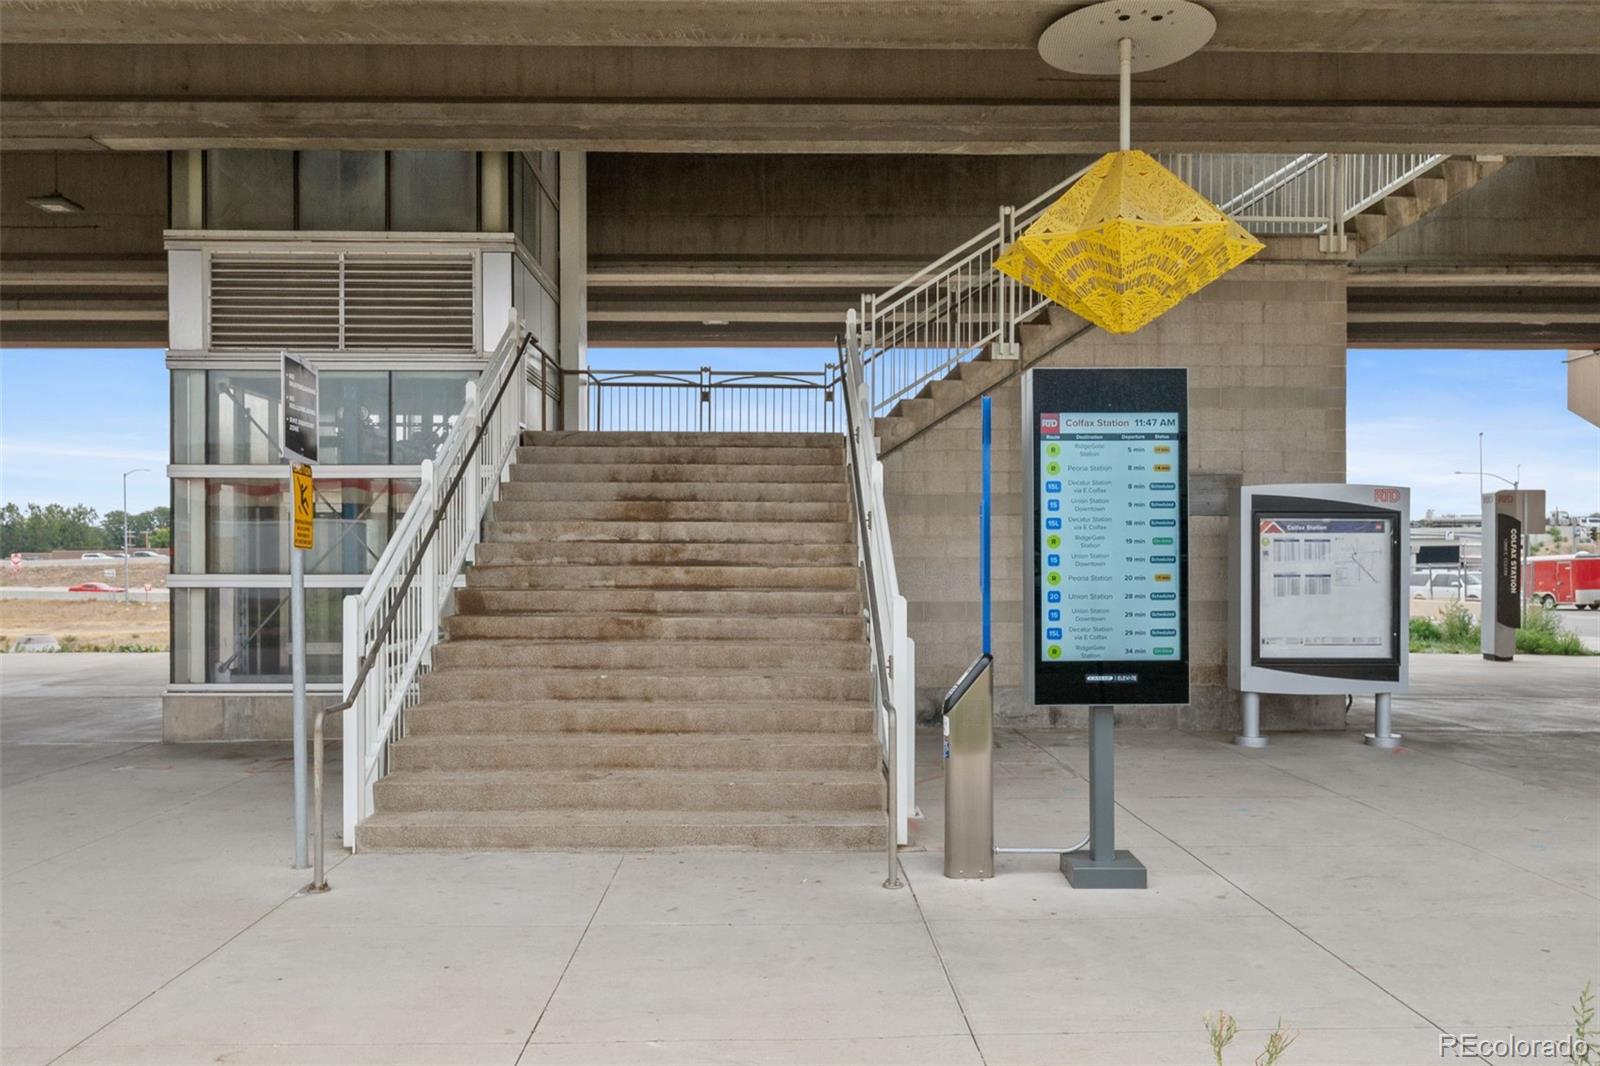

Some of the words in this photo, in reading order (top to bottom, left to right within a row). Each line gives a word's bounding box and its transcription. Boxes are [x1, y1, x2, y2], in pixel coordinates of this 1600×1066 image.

[1066, 419, 1094, 427] Colfax
[1097, 418, 1129, 427] Station
[1375, 488, 1400, 503] RTD
